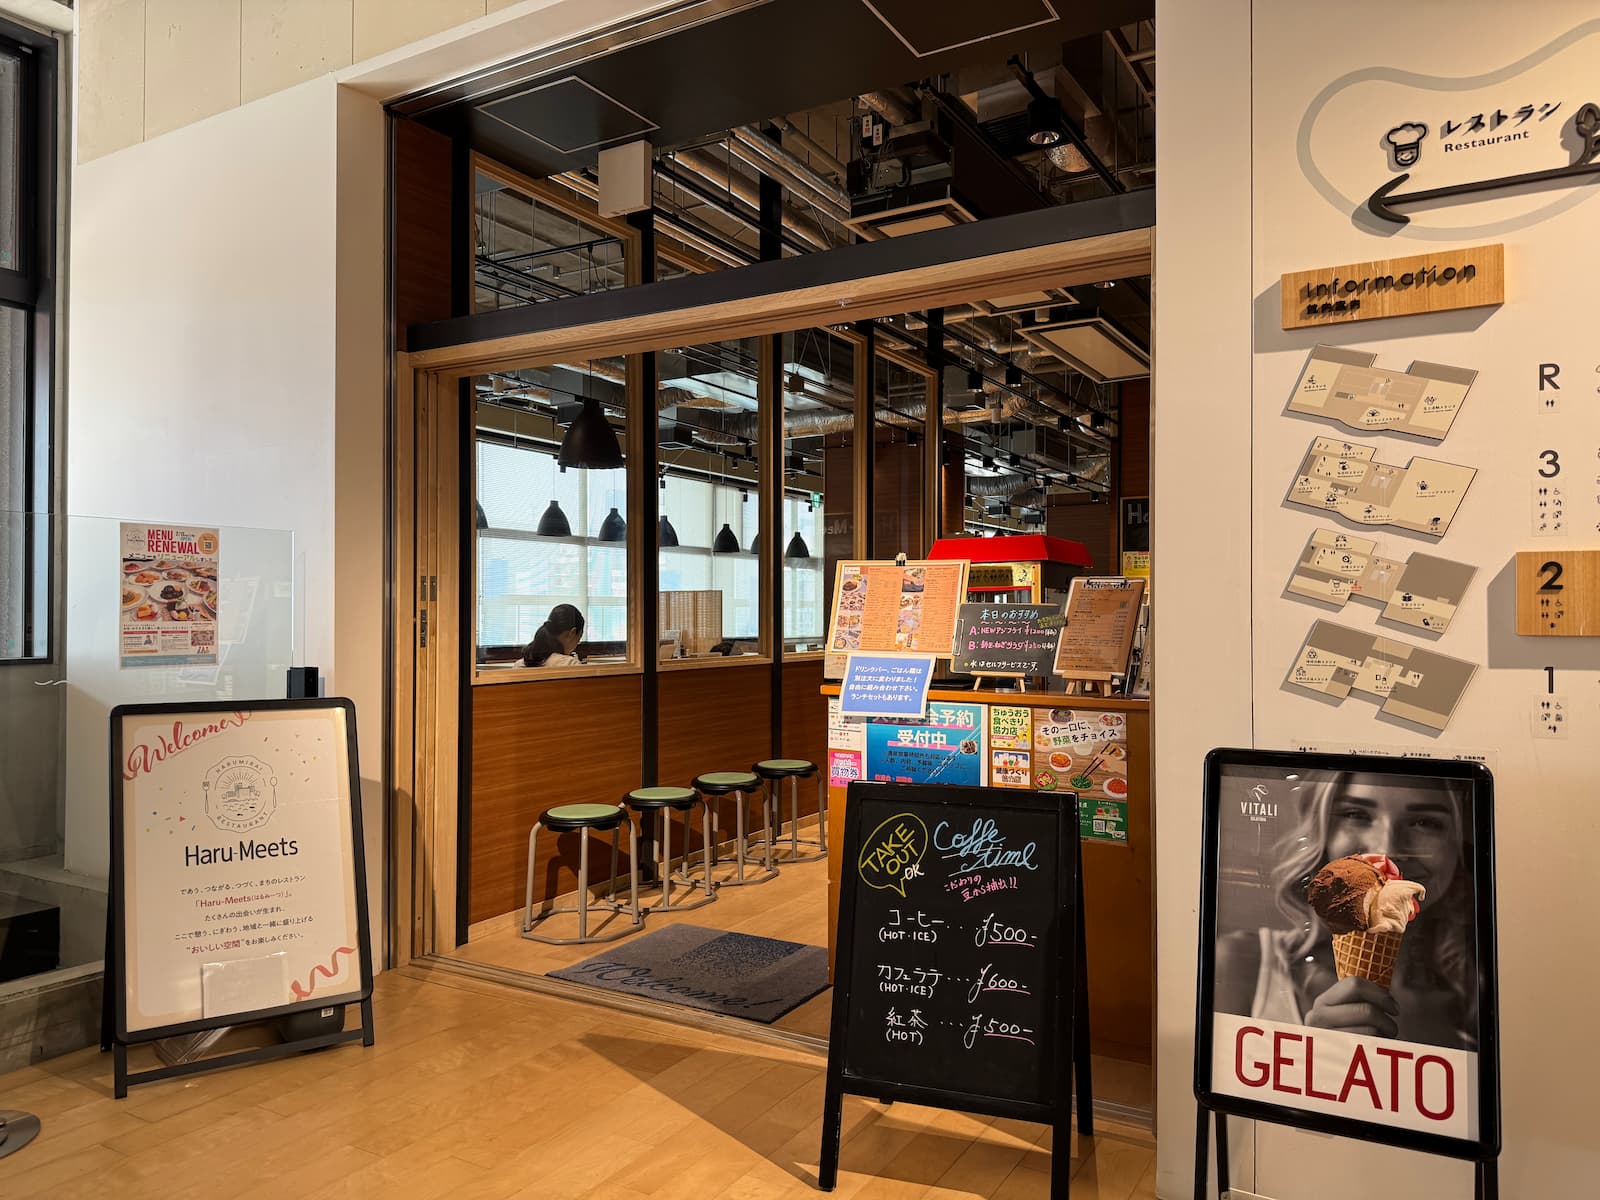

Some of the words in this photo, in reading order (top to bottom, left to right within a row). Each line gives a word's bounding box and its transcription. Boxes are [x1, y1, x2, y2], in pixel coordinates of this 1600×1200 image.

[1445, 101, 1562, 136] レストラン
[1444, 130, 1531, 153] Restaurant
[1306, 263, 1477, 299] Information
[1539, 363, 1561, 391] R
[1538, 449, 1561, 478] 3
[147, 529, 174, 541] MENU
[147, 540, 200, 555] RENEWAL
[1540, 561, 1564, 591] 2
[980, 608, 1038, 620] 本日のおすすめ
[1544, 666, 1554, 694] 1
[993, 708, 1030, 719] ちゅうおう
[993, 717, 1025, 727] 食べきり
[897, 729, 947, 746] 受付中
[993, 726, 1019, 736] 協力店
[1042, 721, 1092, 736] その一口に、
[1052, 729, 1118, 746] 野菜をチョイス
[123, 711, 252, 779] Welcome
[831, 767, 859, 778] 買物券
[1240, 801, 1278, 817] VITALI
[216, 811, 269, 829] RESTAURANT
[185, 837, 299, 867] Haru-Meets
[861, 823, 915, 872] TAKE
[886, 838, 918, 875] OUT
[904, 863, 925, 880] OK
[888, 909, 945, 928] コーヒー
[876, 964, 944, 987] カフェラテ
[885, 1006, 929, 1029] 紅茶
[885, 1027, 924, 1045] (HOT)
[1235, 1026, 1455, 1121] GELATO
